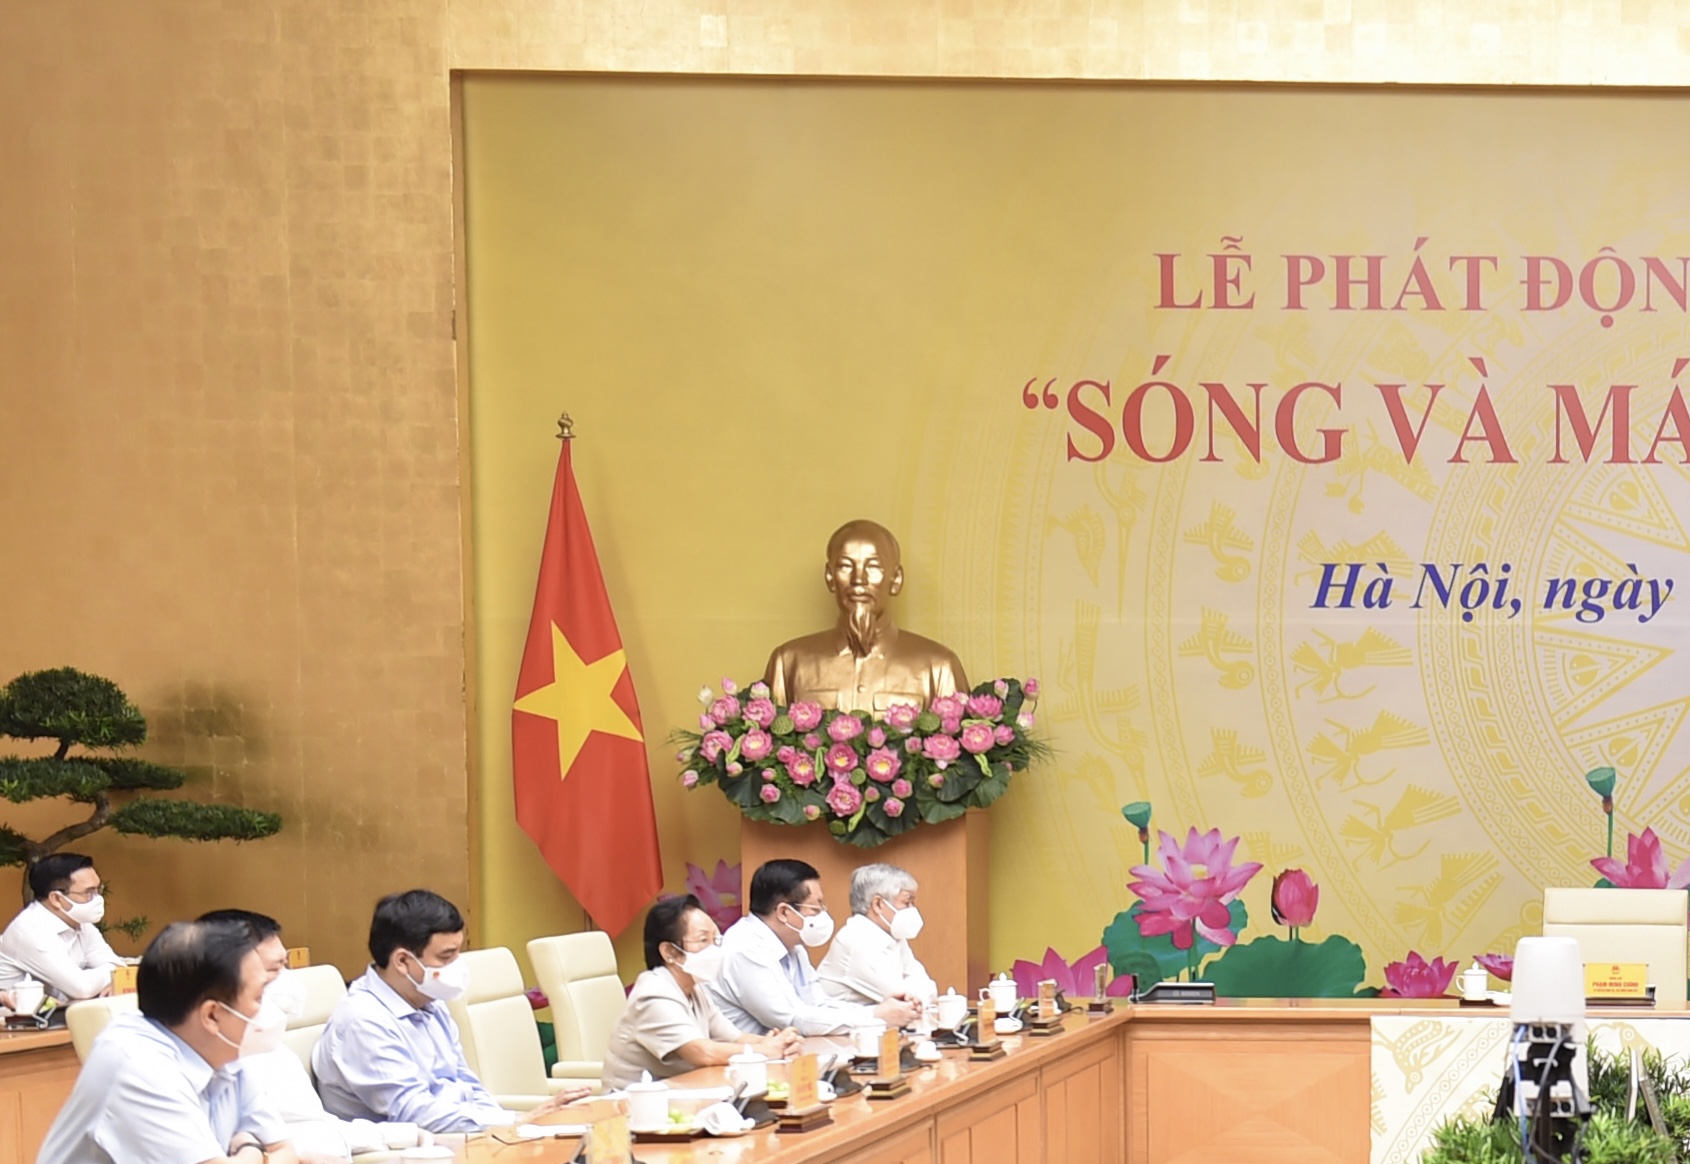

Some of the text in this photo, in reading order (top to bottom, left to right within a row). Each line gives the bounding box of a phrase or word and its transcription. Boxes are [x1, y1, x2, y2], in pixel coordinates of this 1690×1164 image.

[1153, 235, 1256, 310] LỄ
[1280, 236, 1498, 312] PHÁT
[1022, 354, 1349, 464] “SÓNG
[1375, 356, 1519, 465] VÀ
[1308, 561, 1395, 611] Hà
[1411, 563, 1523, 622] Nội,
[1542, 564, 1675, 624] ngày
